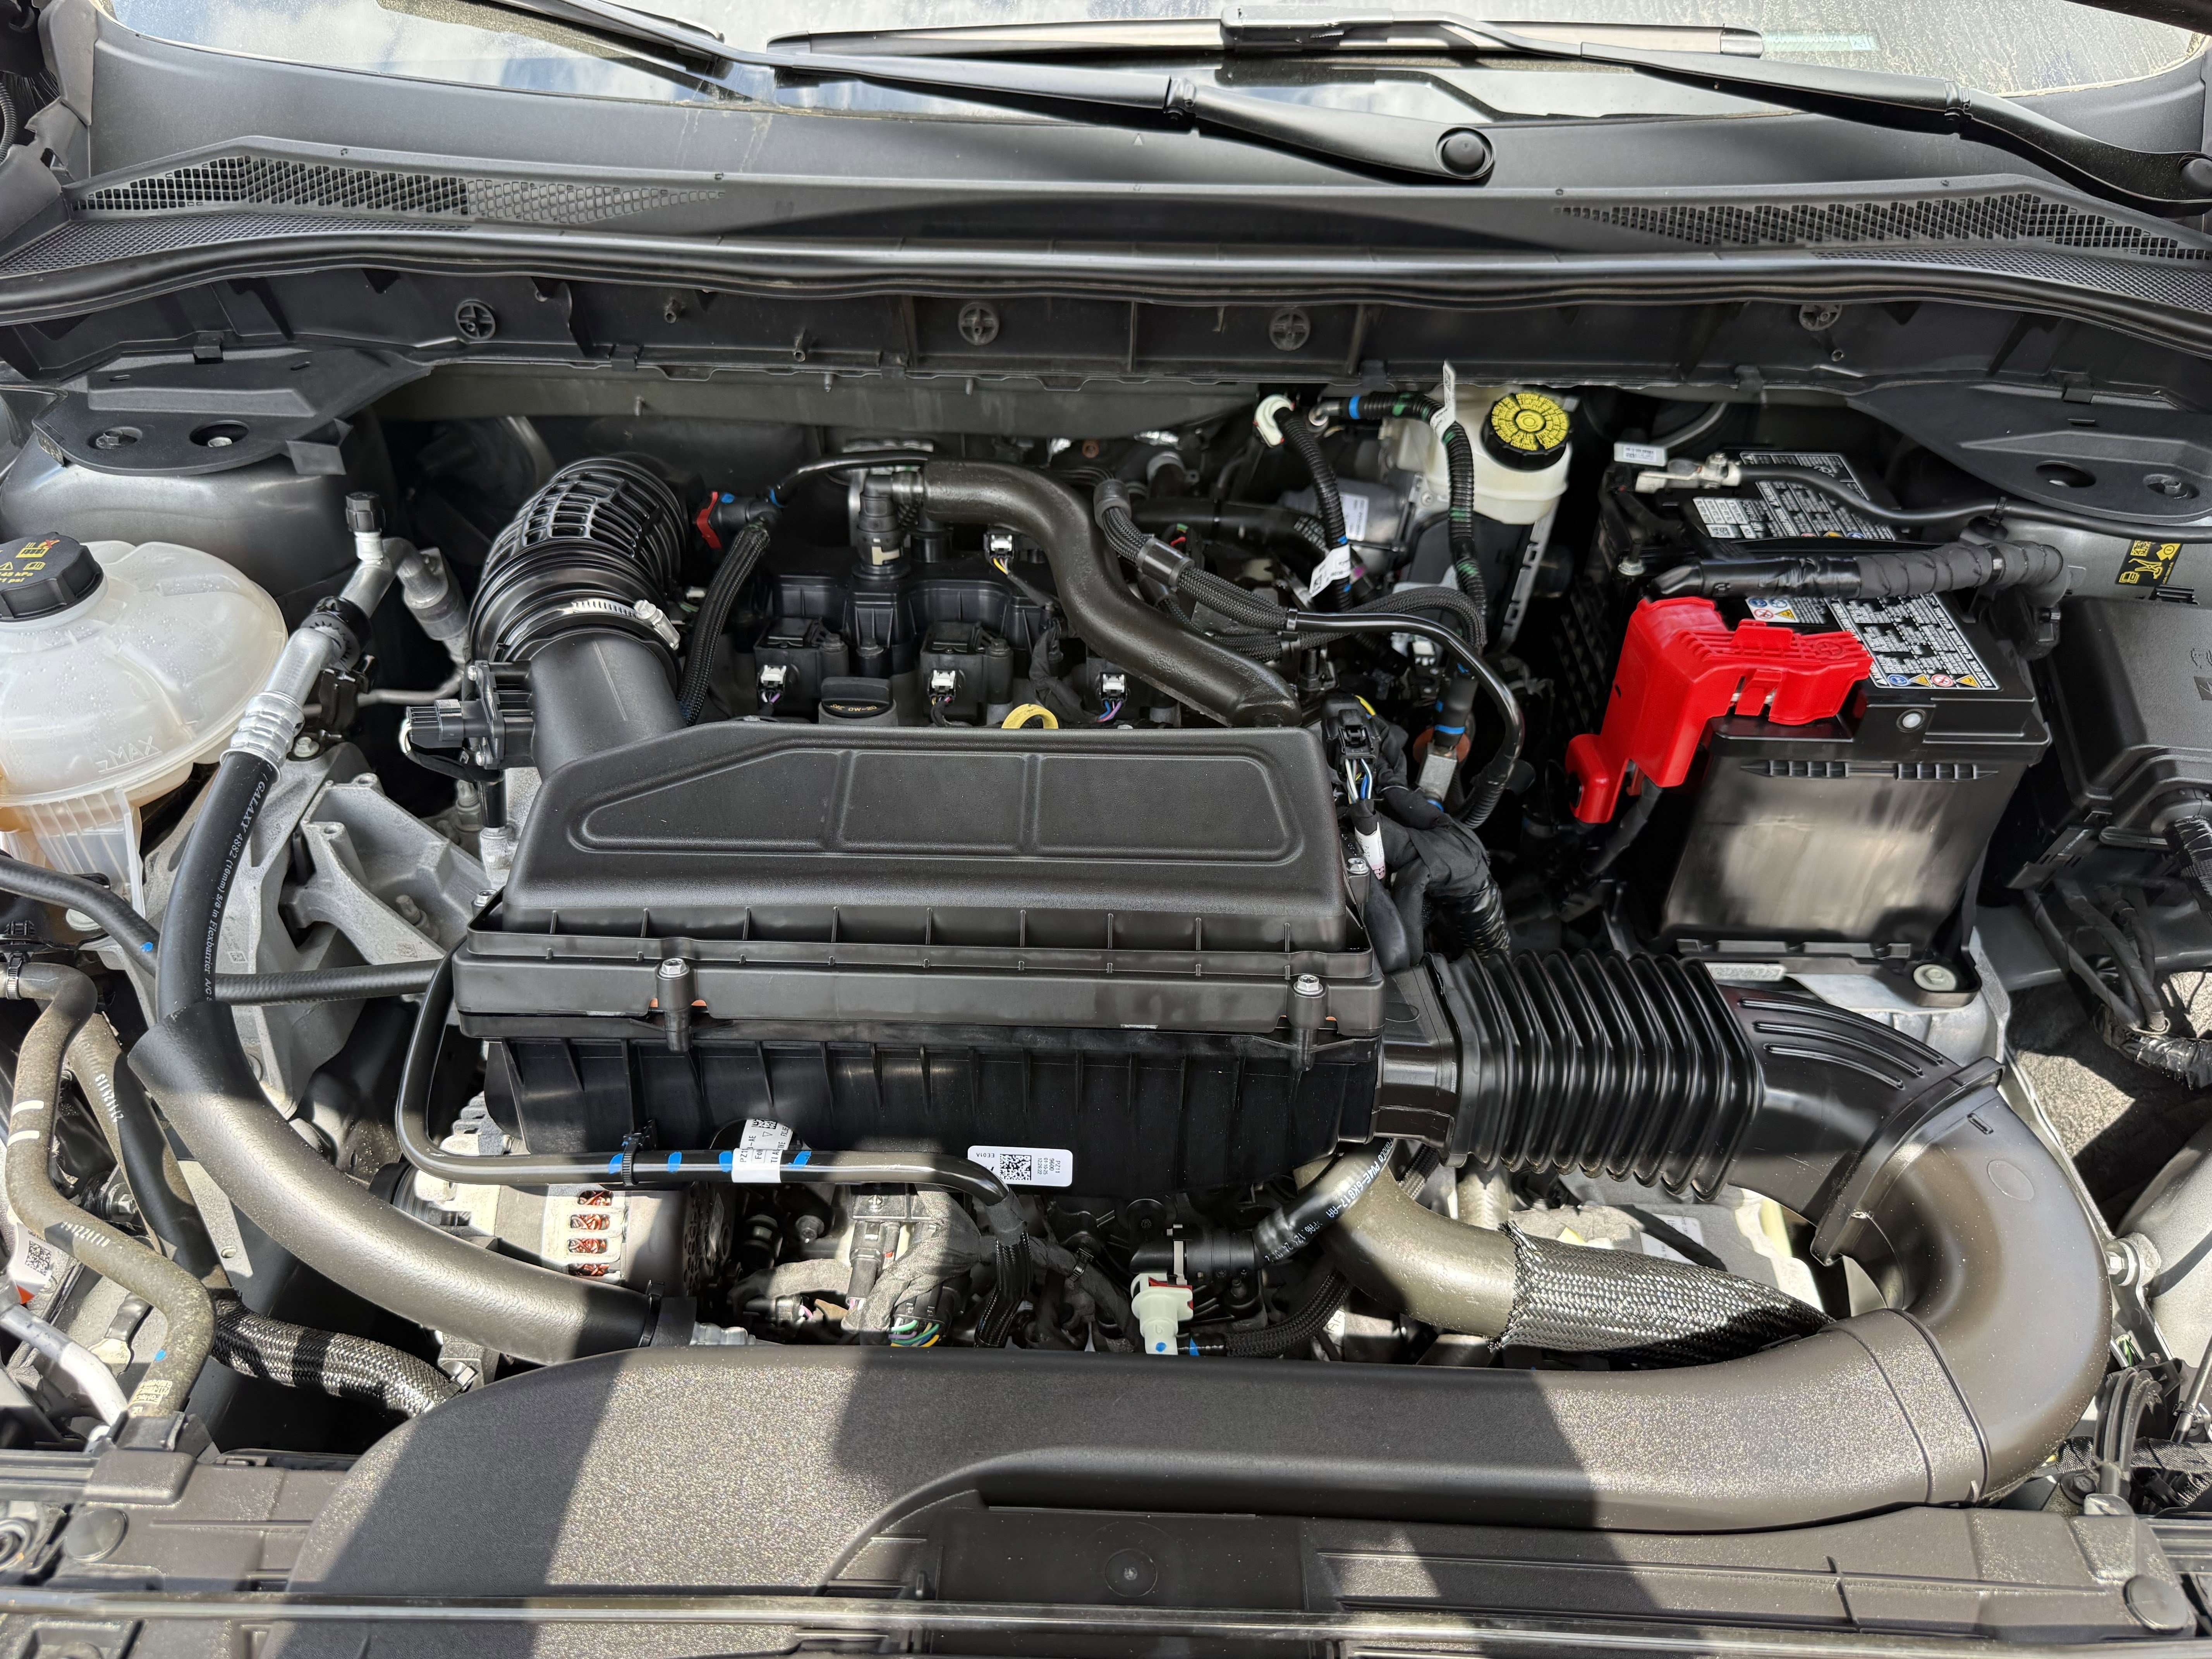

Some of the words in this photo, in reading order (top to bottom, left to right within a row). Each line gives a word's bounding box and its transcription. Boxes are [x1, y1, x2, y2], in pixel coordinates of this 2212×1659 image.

[108, 735, 159, 766] MAX
[240, 780, 267, 834] GALAXY
[229, 833, 245, 859] 4882
[217, 859, 233, 893] (16mm)
[204, 919, 218, 975] Flexbarrier
[204, 979, 213, 996] A/C
